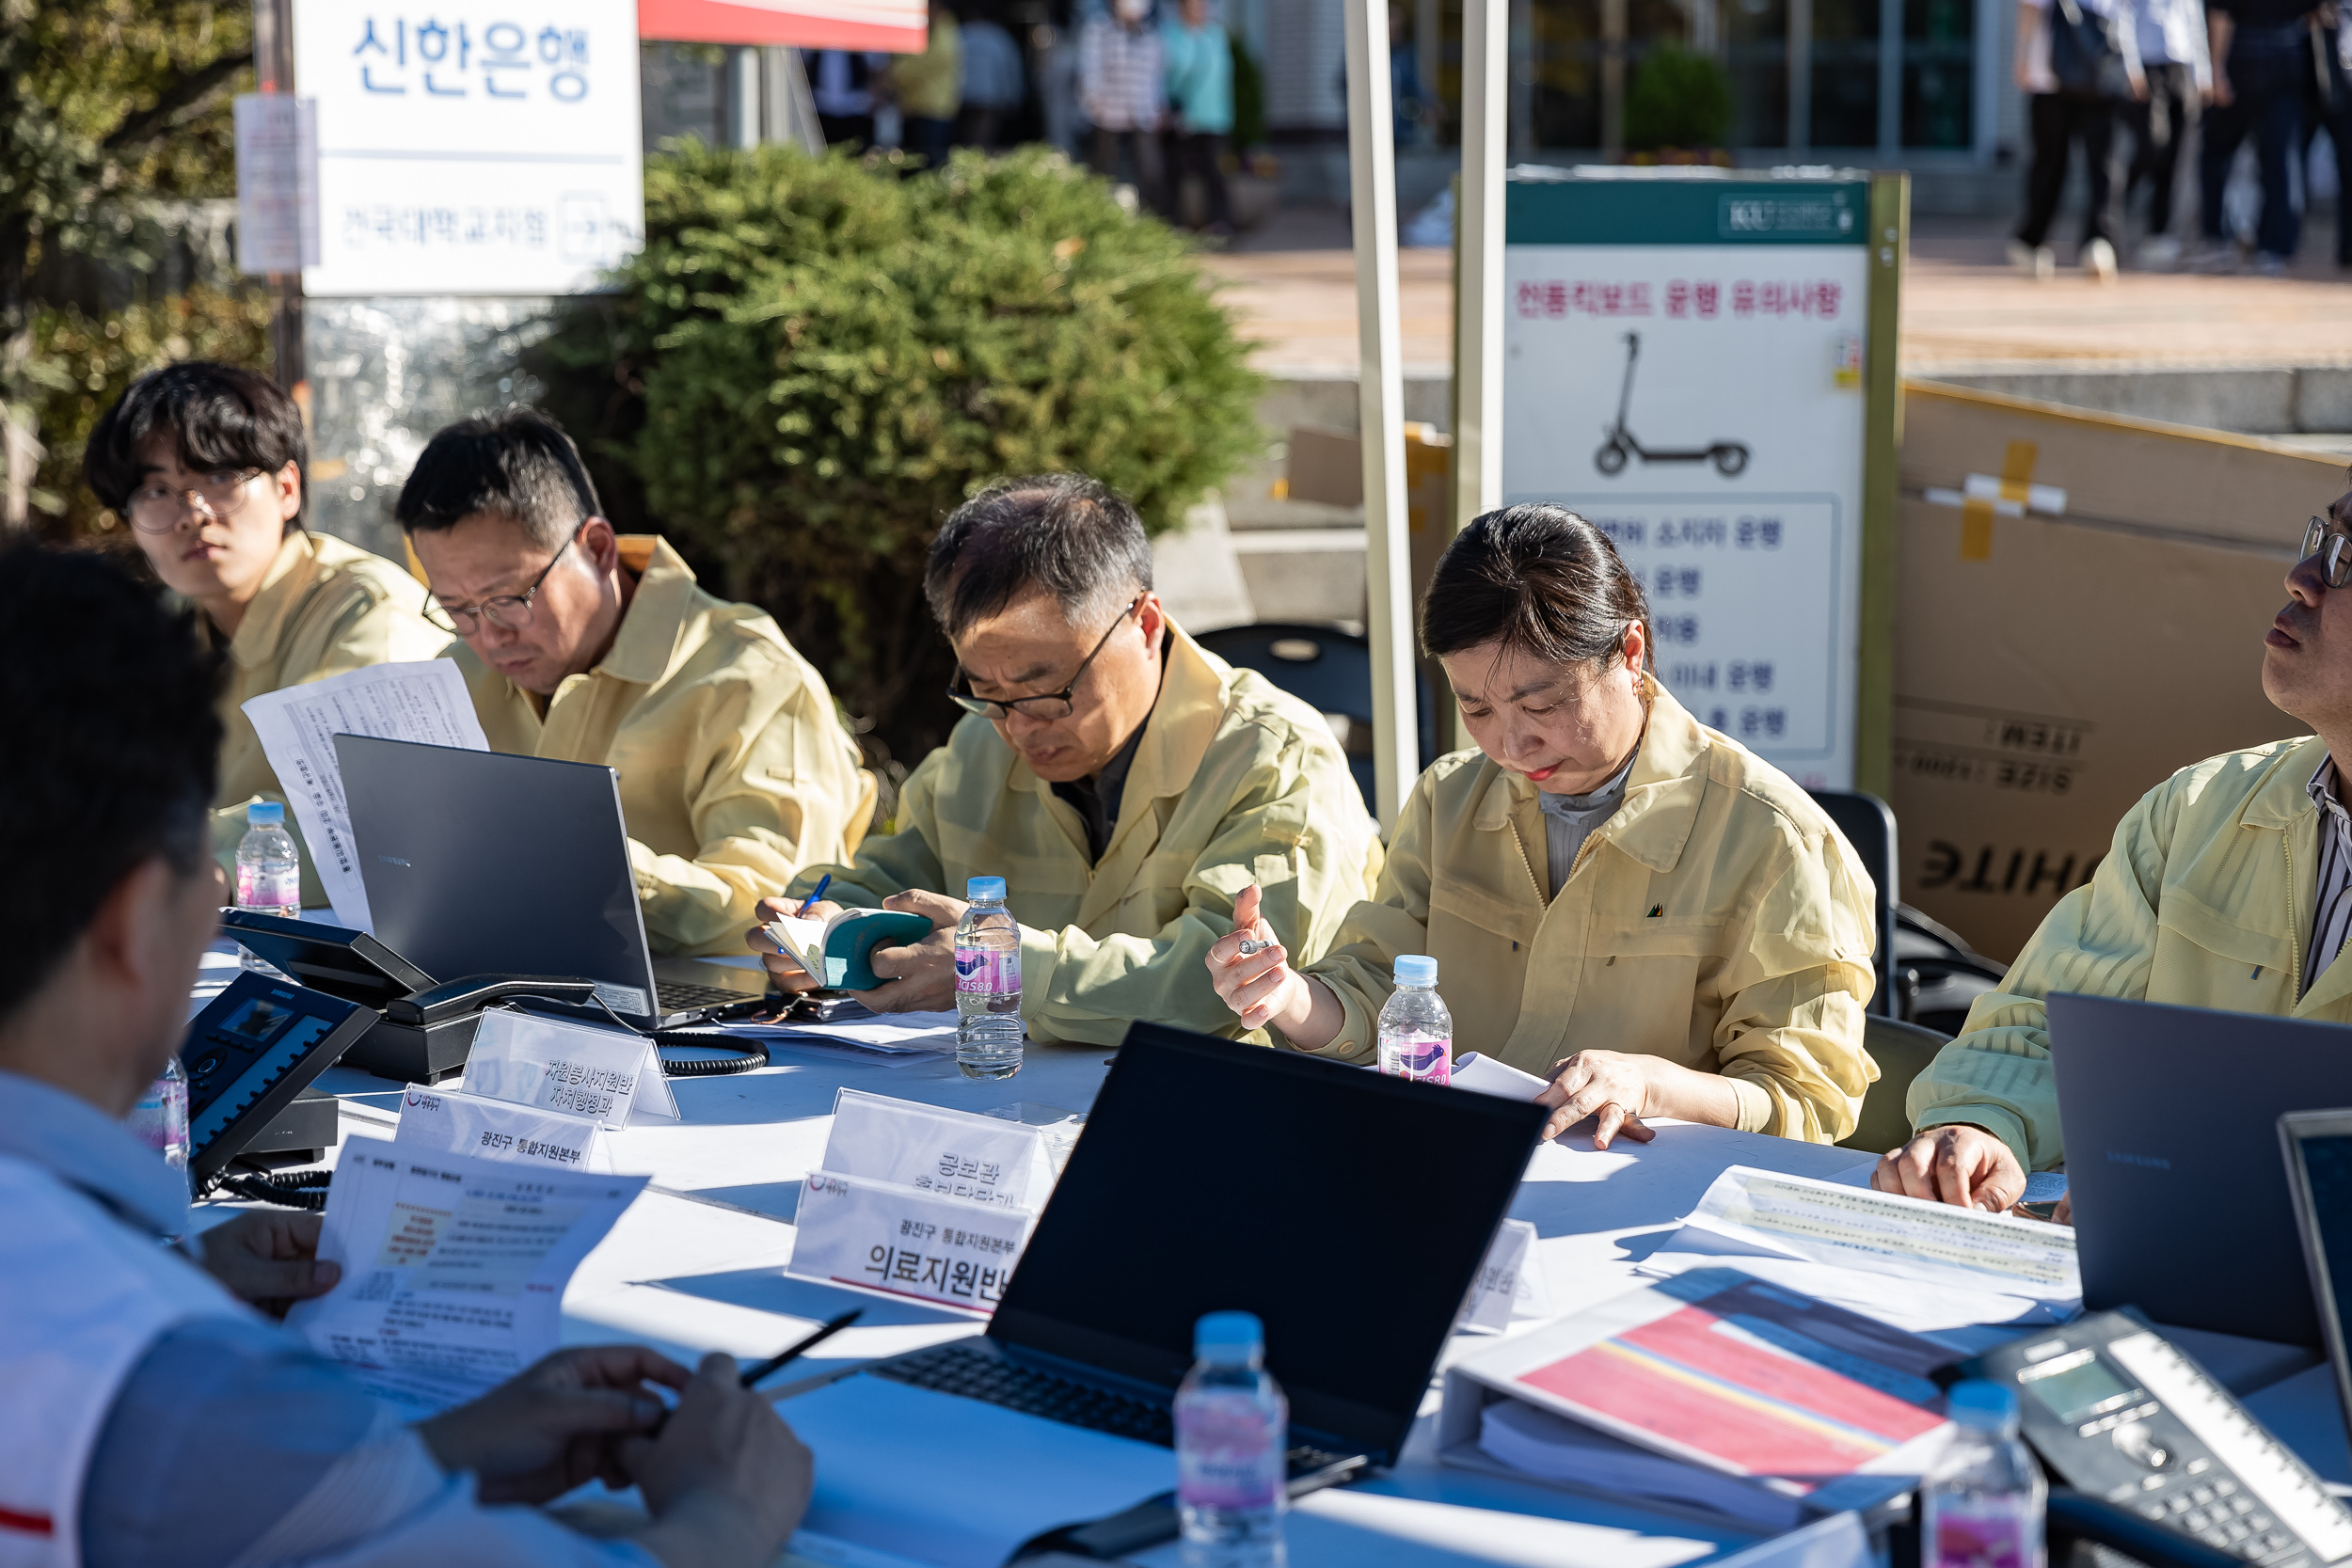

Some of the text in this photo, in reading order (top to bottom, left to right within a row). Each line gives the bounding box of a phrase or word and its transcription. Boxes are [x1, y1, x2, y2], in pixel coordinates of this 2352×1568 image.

[352, 16, 590, 103] 신한은행
[1664, 279, 1721, 320] 운행
[1733, 279, 1841, 321] 유의사항
[1655, 517, 1727, 549] 소지자
[1736, 517, 1784, 552] 운행
[1654, 566, 1702, 600] 운행
[1729, 660, 1775, 694] 운행
[1740, 707, 1786, 738] 운행
[2001, 719, 2082, 755] ITEM
[1995, 760, 2073, 794] SIZE
[270, 989, 294, 1000] SAMSUNG
[546, 1059, 634, 1095] 자원봉사지원반
[549, 1085, 613, 1117] 자치행정과
[481, 1132, 580, 1164] 광진구 통합지원본부
[939, 1151, 1000, 1185] 공보관
[899, 1218, 1015, 1256] 광진구 통합지원본부
[864, 1243, 1012, 1303] 의료지원반
